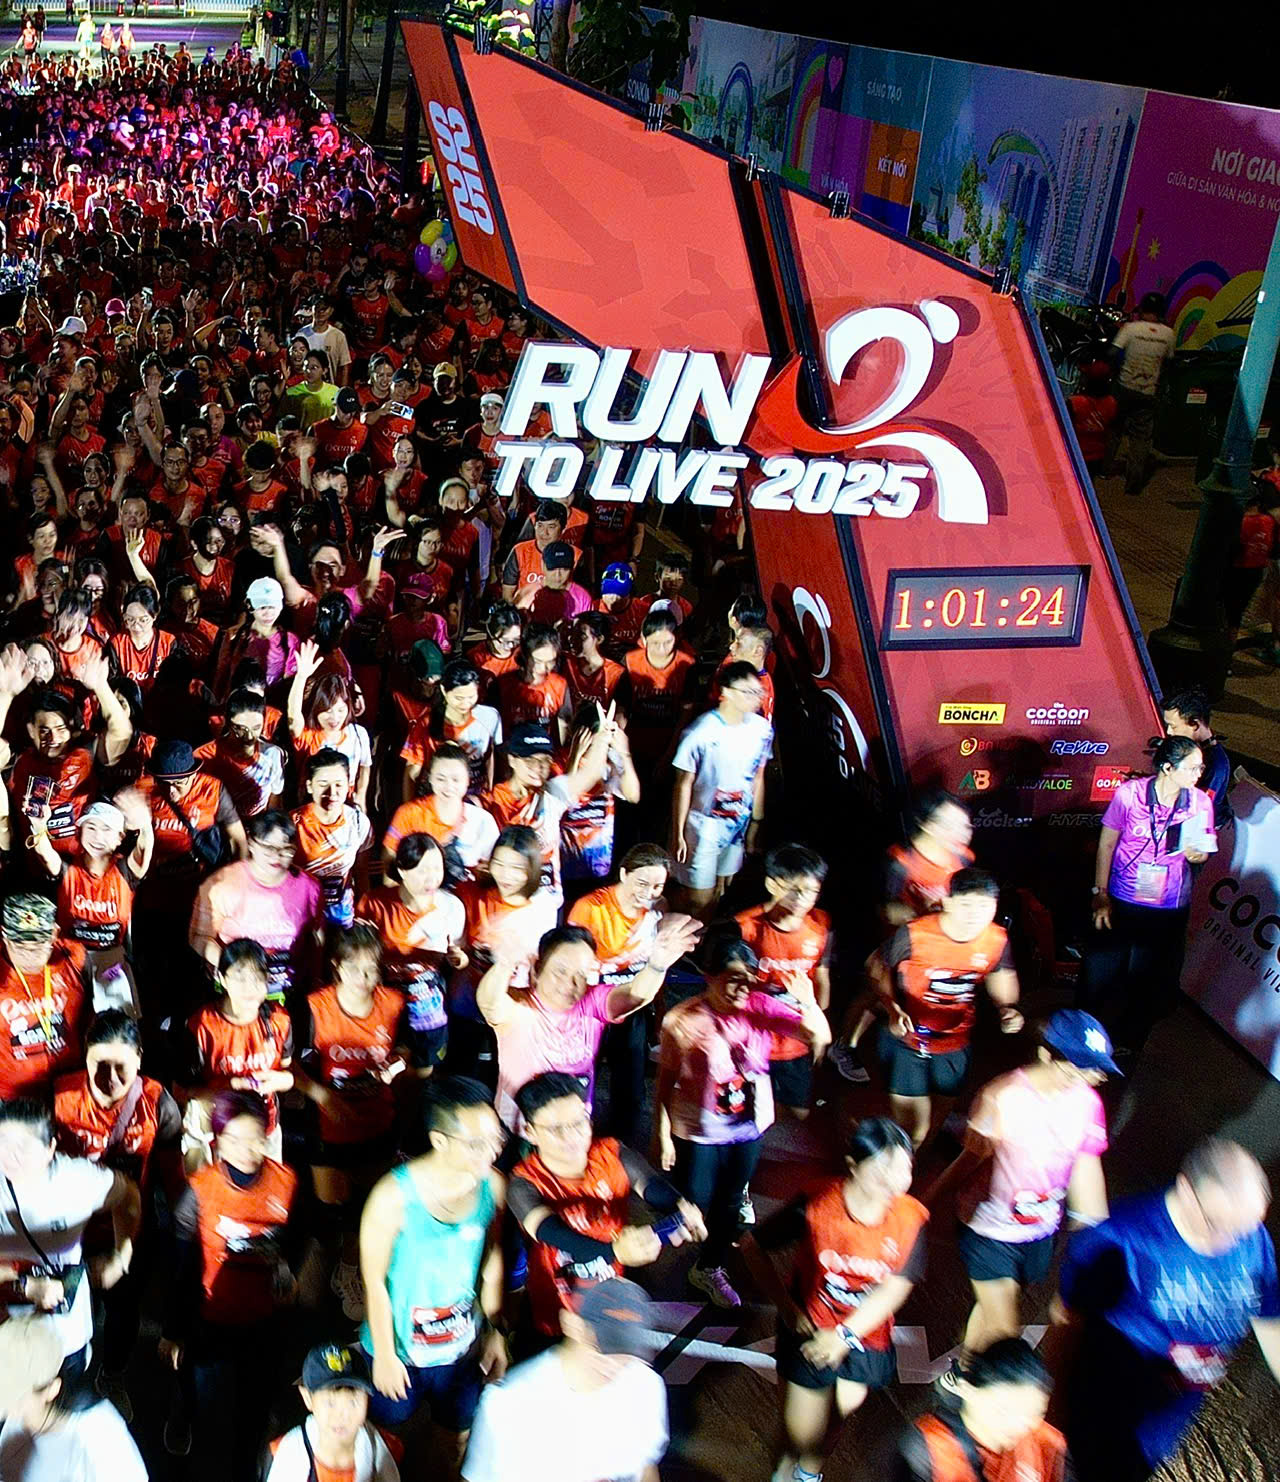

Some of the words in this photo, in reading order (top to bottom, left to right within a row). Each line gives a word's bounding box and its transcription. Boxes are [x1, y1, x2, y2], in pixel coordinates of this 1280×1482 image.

[1211, 147, 1245, 177] NƠI
[1246, 156, 1280, 186] GIA
[499, 338, 772, 447] RUN
[493, 440, 586, 499] TO
[589, 446, 750, 508] LIVE
[750, 455, 933, 519] 2025
[895, 586, 1065, 629] 1:01:24
[944, 710, 997, 721] BONCHA
[1026, 708, 1089, 720] cocoon
[1203, 917, 1262, 971] ORIGINAL
[1208, 877, 1280, 963] COC
